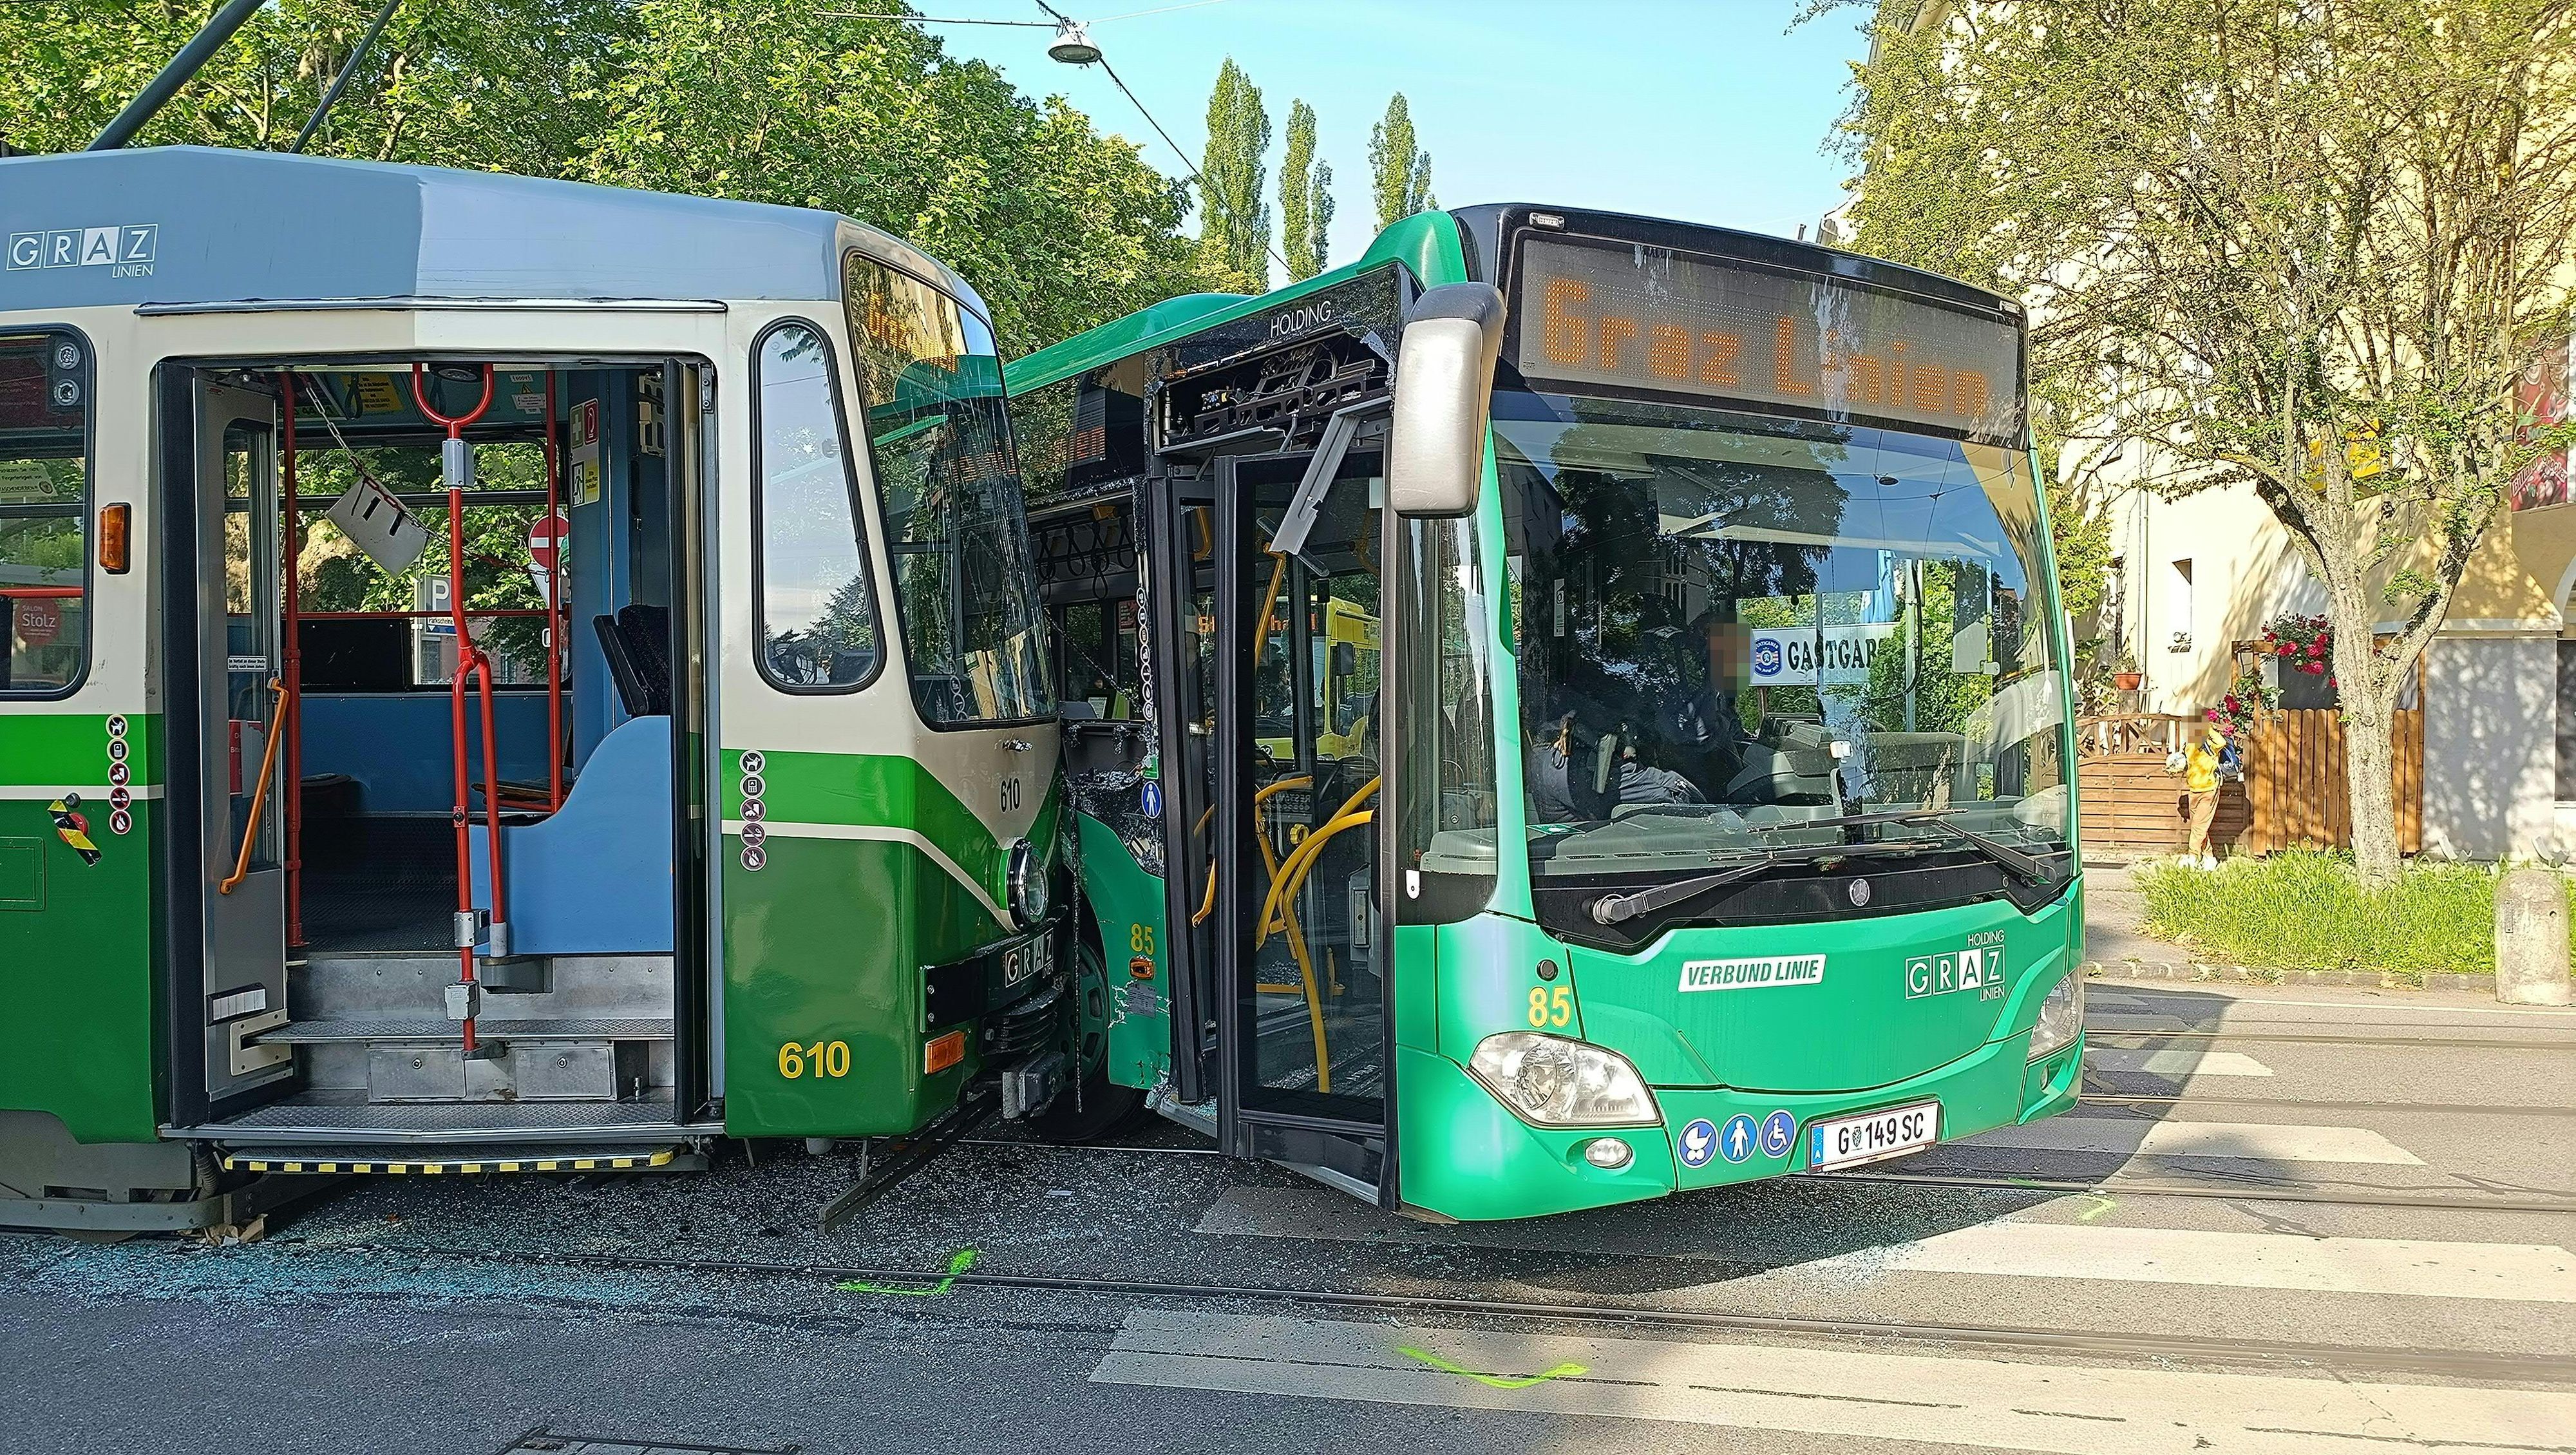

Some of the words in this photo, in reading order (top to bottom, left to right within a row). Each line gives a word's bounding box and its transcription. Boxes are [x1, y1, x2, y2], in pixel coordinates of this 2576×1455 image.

[12, 229, 150, 267] GRAZ
[112, 263, 154, 278] LINIEN
[1270, 300, 1331, 338] HOLDING
[1547, 277, 1742, 386] Graz
[1776, 316, 1987, 417] Linien
[431, 580, 450, 612] P
[22, 613, 56, 627] Stolz
[1000, 777, 1021, 813] 610
[1130, 923, 1155, 955] 85
[1967, 929, 2005, 947] HOLDING
[1007, 933, 1052, 982] GRAZ
[1688, 964, 1772, 986] VERBUND
[1775, 960, 1819, 982] LINIE
[1909, 951, 2001, 994] GRAZ
[1528, 985, 1571, 1028] 85
[1980, 985, 2005, 1002] LINIEN
[778, 1040, 851, 1079] 610
[1839, 1127, 1850, 1155] G
[1865, 1117, 1897, 1149] 149
[1902, 1112, 1924, 1141] SC
